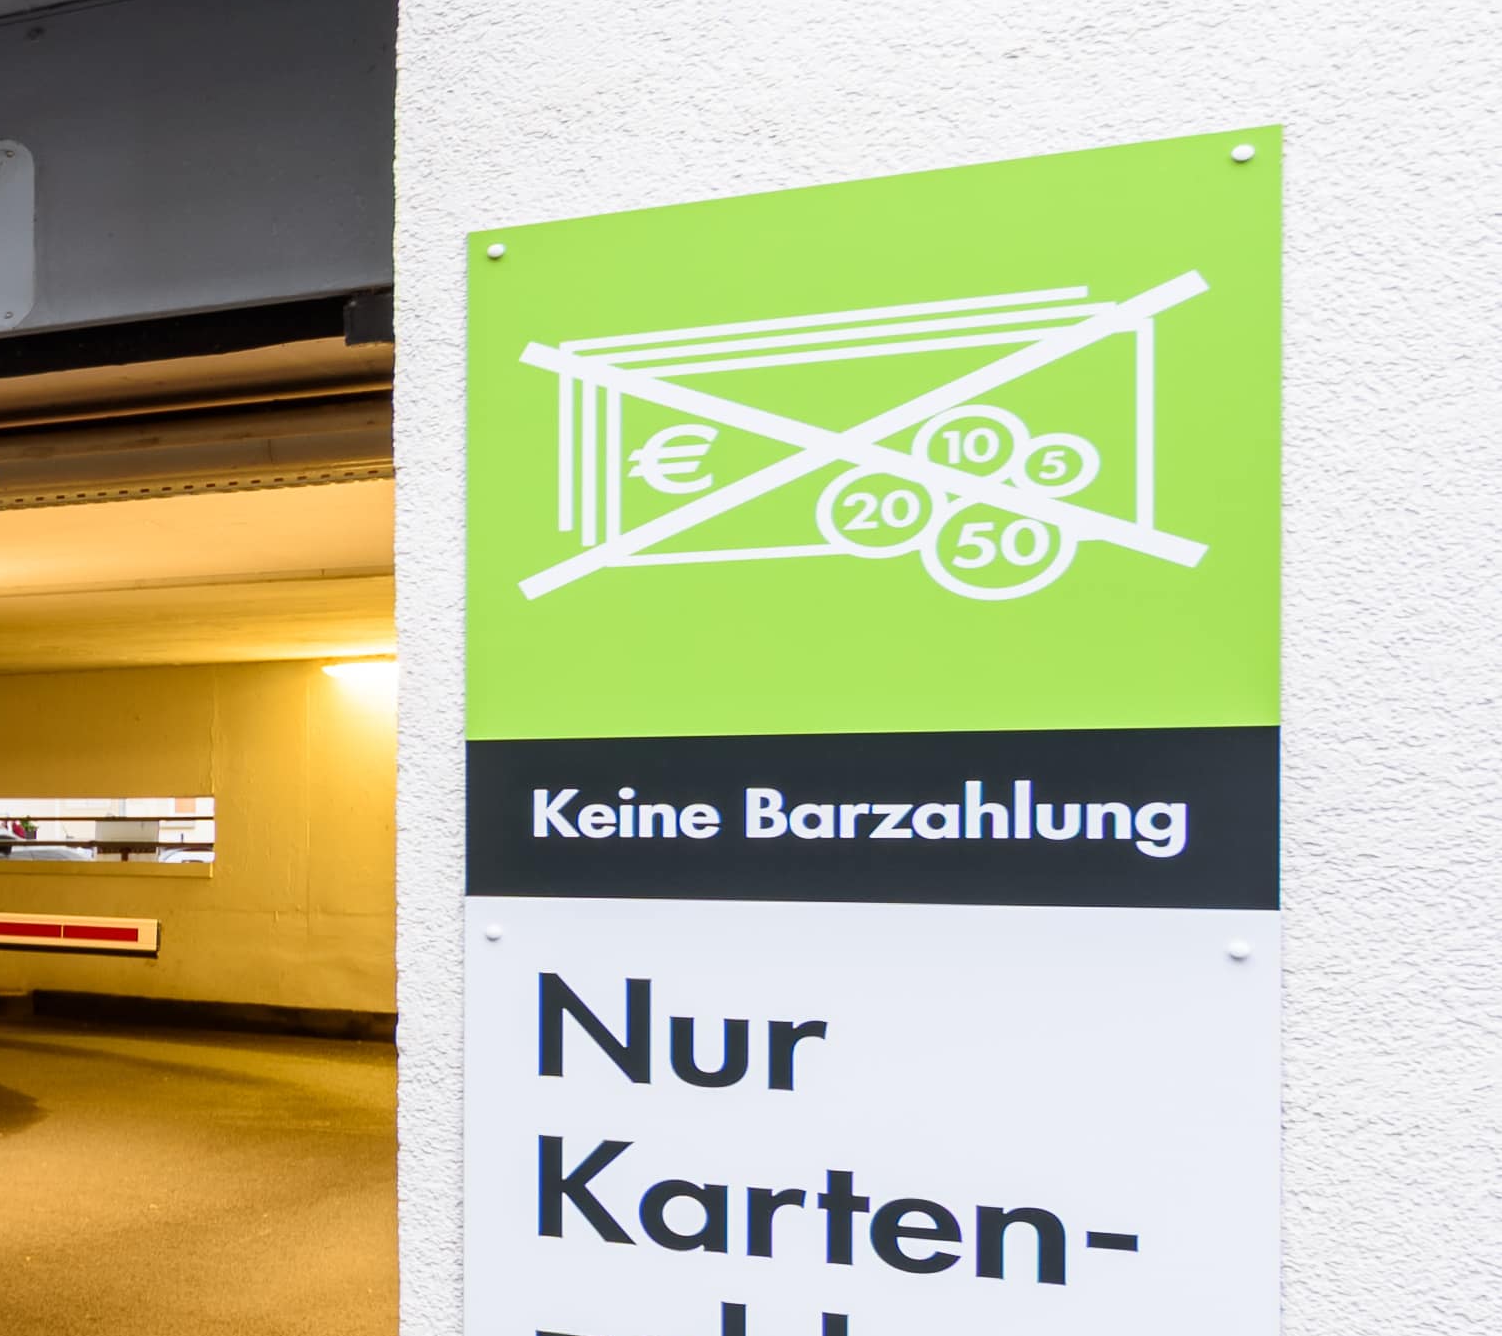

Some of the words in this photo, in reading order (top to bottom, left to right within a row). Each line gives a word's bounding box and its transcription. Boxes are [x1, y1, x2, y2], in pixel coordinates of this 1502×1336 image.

[628, 424, 719, 495] €
[942, 427, 1000, 465] 10
[1040, 450, 1066, 480] 5
[842, 489, 920, 531] 20
[952, 518, 1050, 569] 50
[531, 787, 720, 839] Keine
[744, 780, 1187, 858] Barzahlung
[535, 973, 828, 1093] Nur
[535, 1134, 1140, 1285] Karten-
